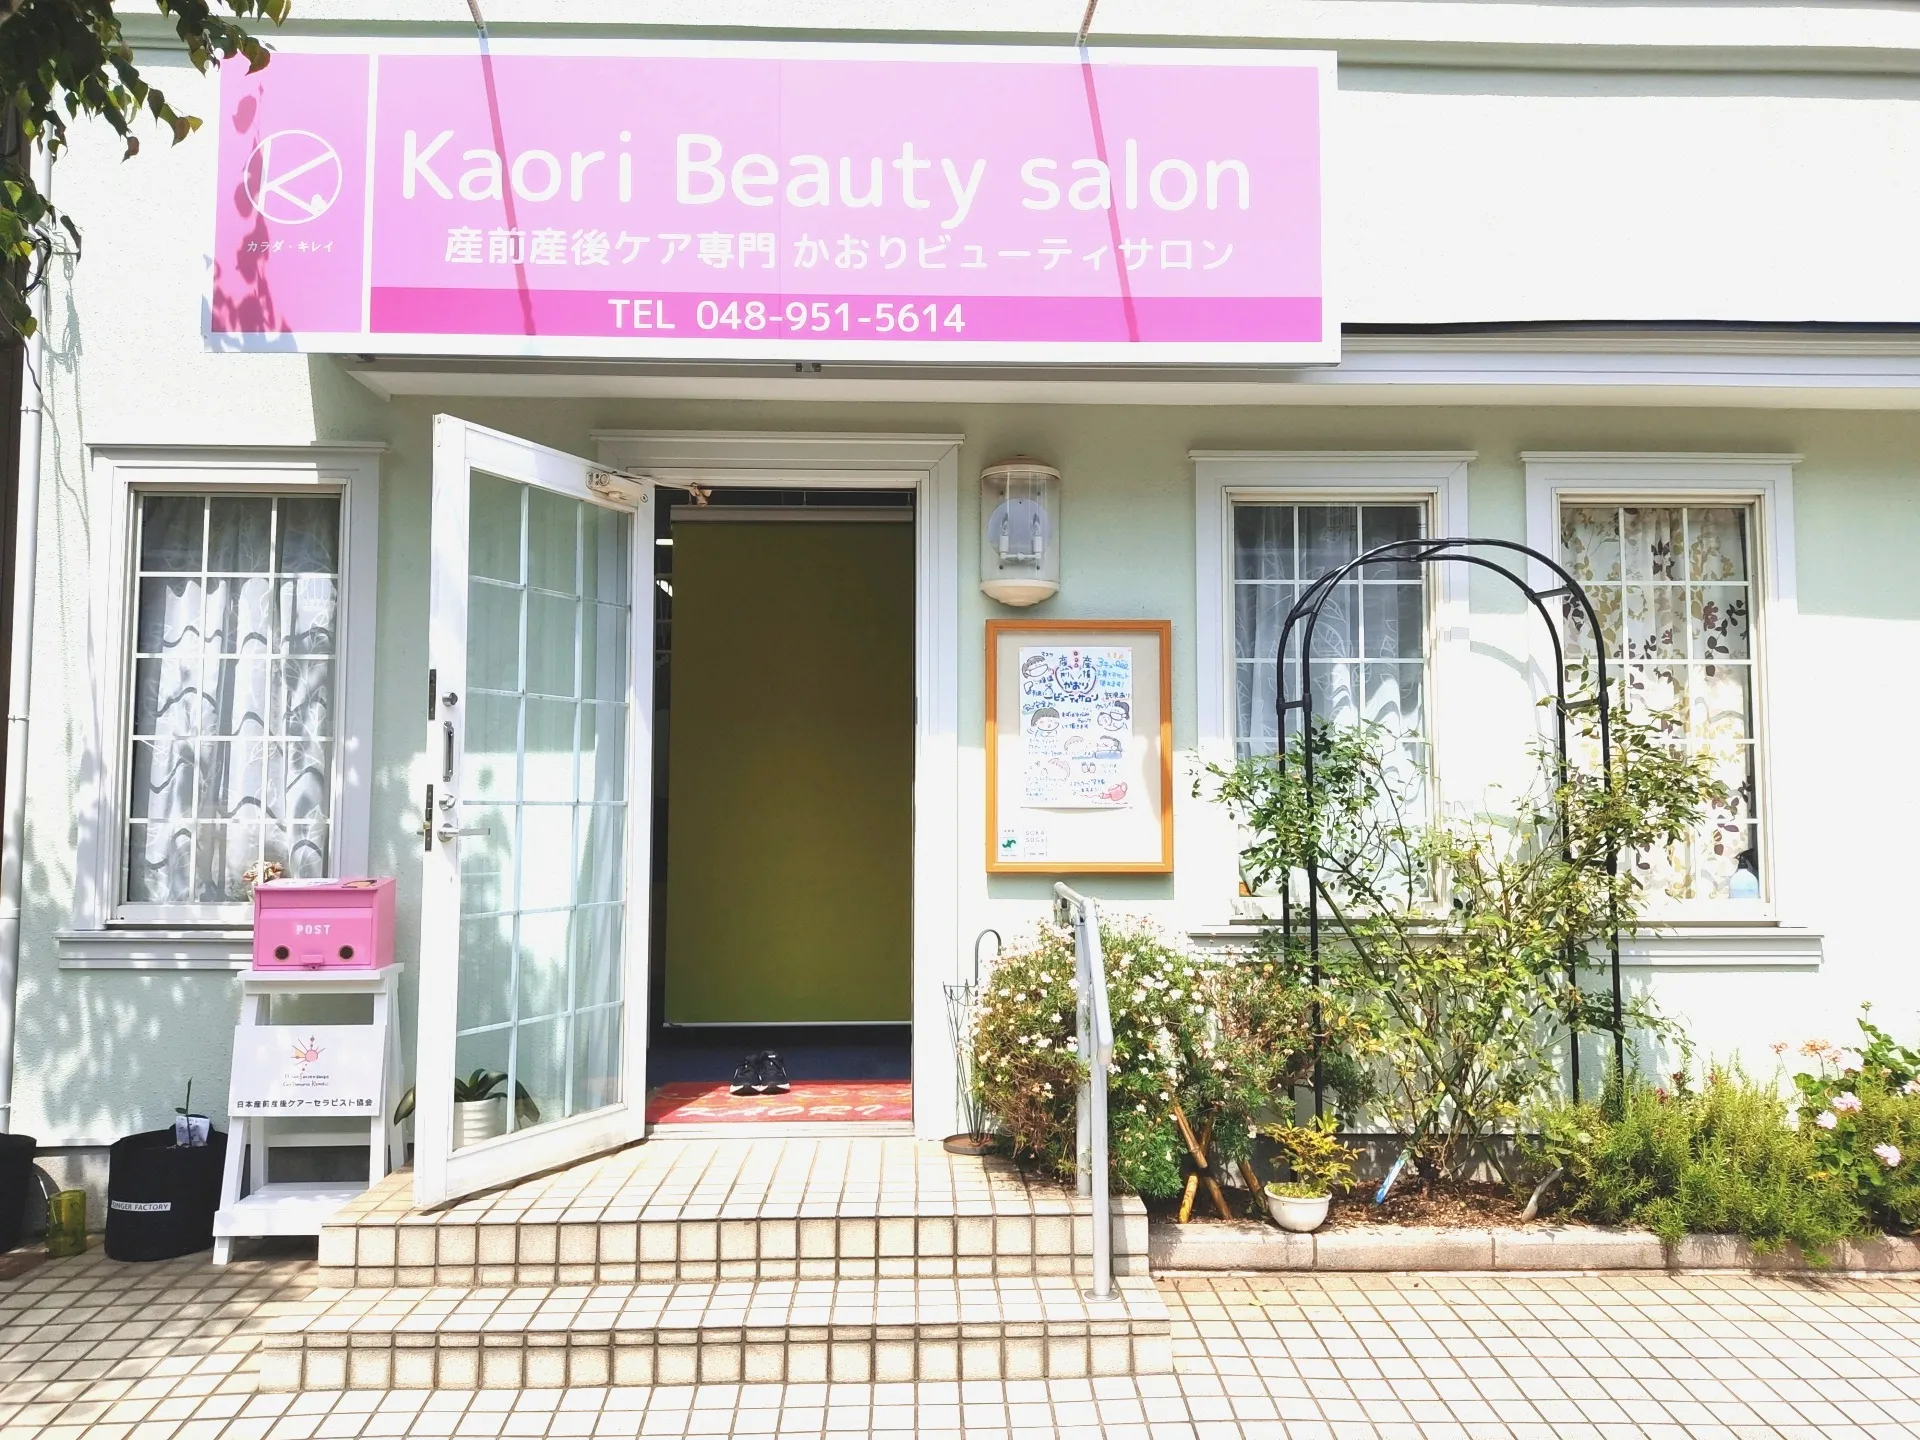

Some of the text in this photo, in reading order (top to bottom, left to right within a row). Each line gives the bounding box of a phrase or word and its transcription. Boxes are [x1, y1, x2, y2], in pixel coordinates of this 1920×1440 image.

[402, 130, 1250, 230] Kaori Beauty salon
[246, 240, 334, 253] カラダ・キレイ
[445, 225, 1235, 271] 産前産後ケア専門 かおりビューティサロン
[608, 299, 967, 333] TEL 048-951-5614
[1053, 692, 1099, 703] ビューティサロン
[295, 924, 332, 935] POST
[236, 1098, 373, 1109] 日本産前産後ケアーセラピスト協会
[134, 1203, 169, 1211] FACTORY
